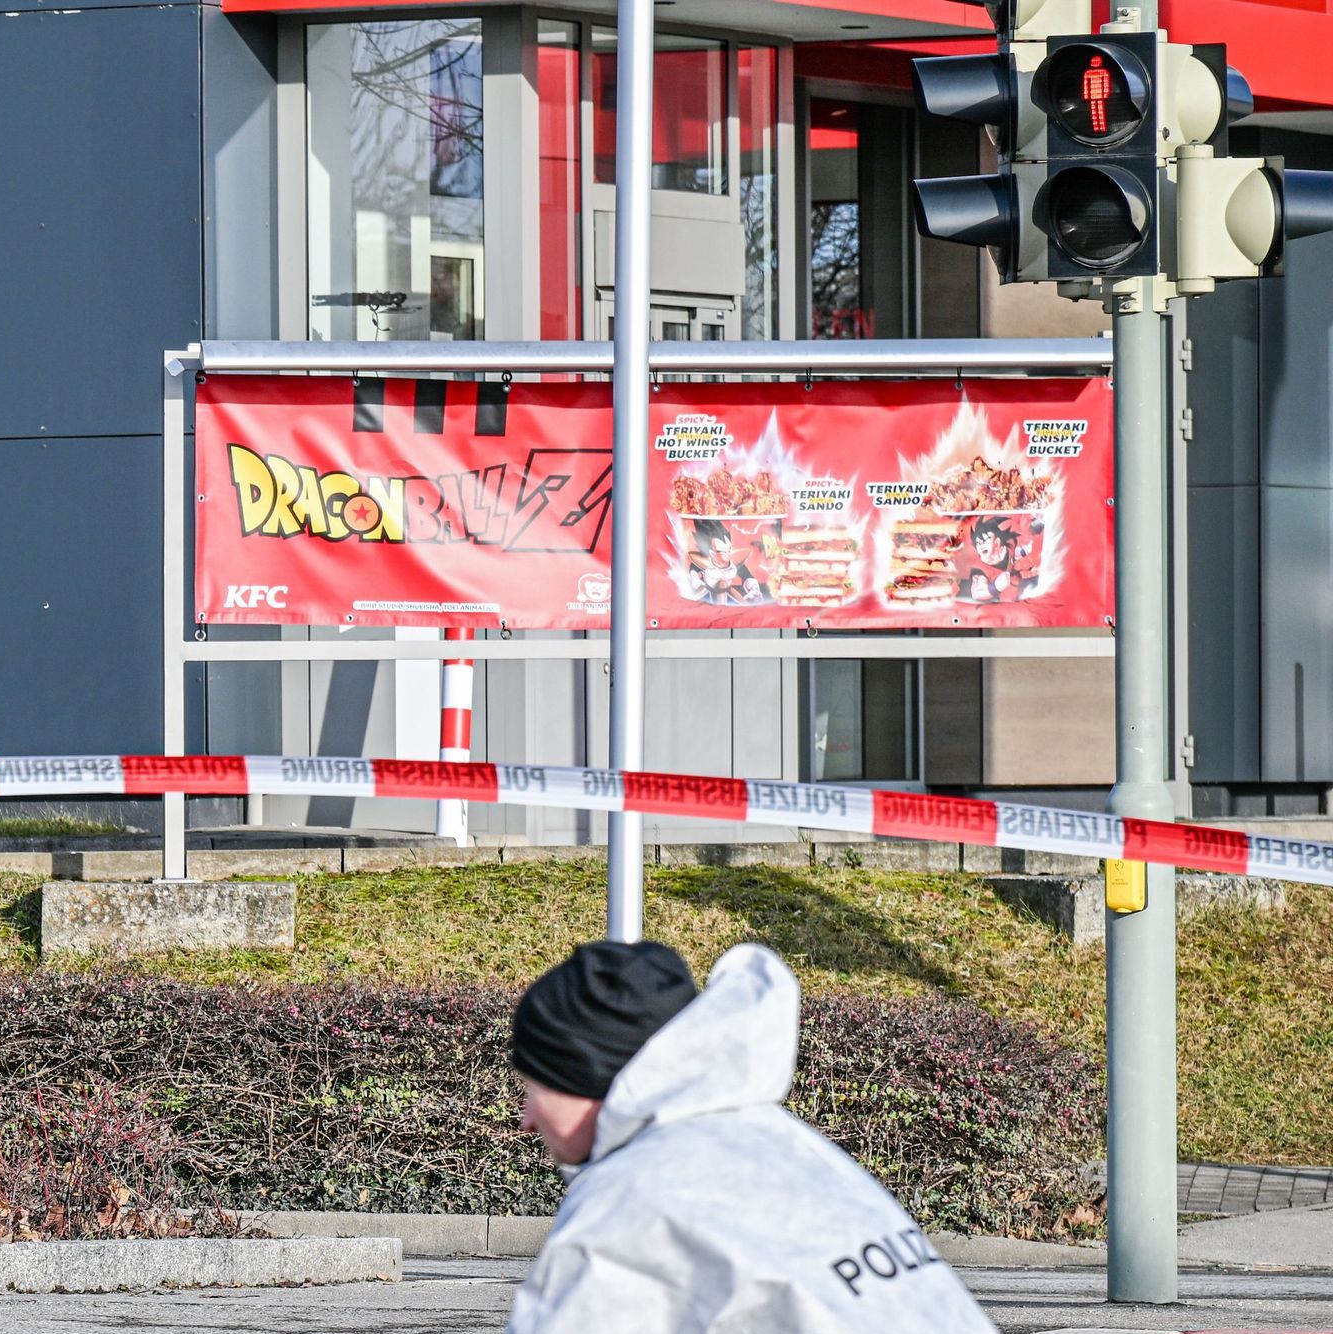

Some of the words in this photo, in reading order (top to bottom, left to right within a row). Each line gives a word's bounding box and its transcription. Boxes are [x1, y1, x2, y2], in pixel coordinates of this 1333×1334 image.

[678, 416, 705, 424] SPICY
[666, 426, 723, 435] TERIYAKI
[1026, 423, 1085, 431] TERIYAKI
[658, 437, 682, 447] HOT
[1031, 434, 1078, 443] CRISPY
[669, 449, 717, 459] BUCKET
[1029, 446, 1080, 454] BUCKET
[868, 484, 928, 494] TERIYAKI
[792, 489, 851, 499] TERIYAKI
[875, 496, 921, 506] SANDO
[799, 502, 843, 511] SANDO
[223, 585, 289, 609] KFC
